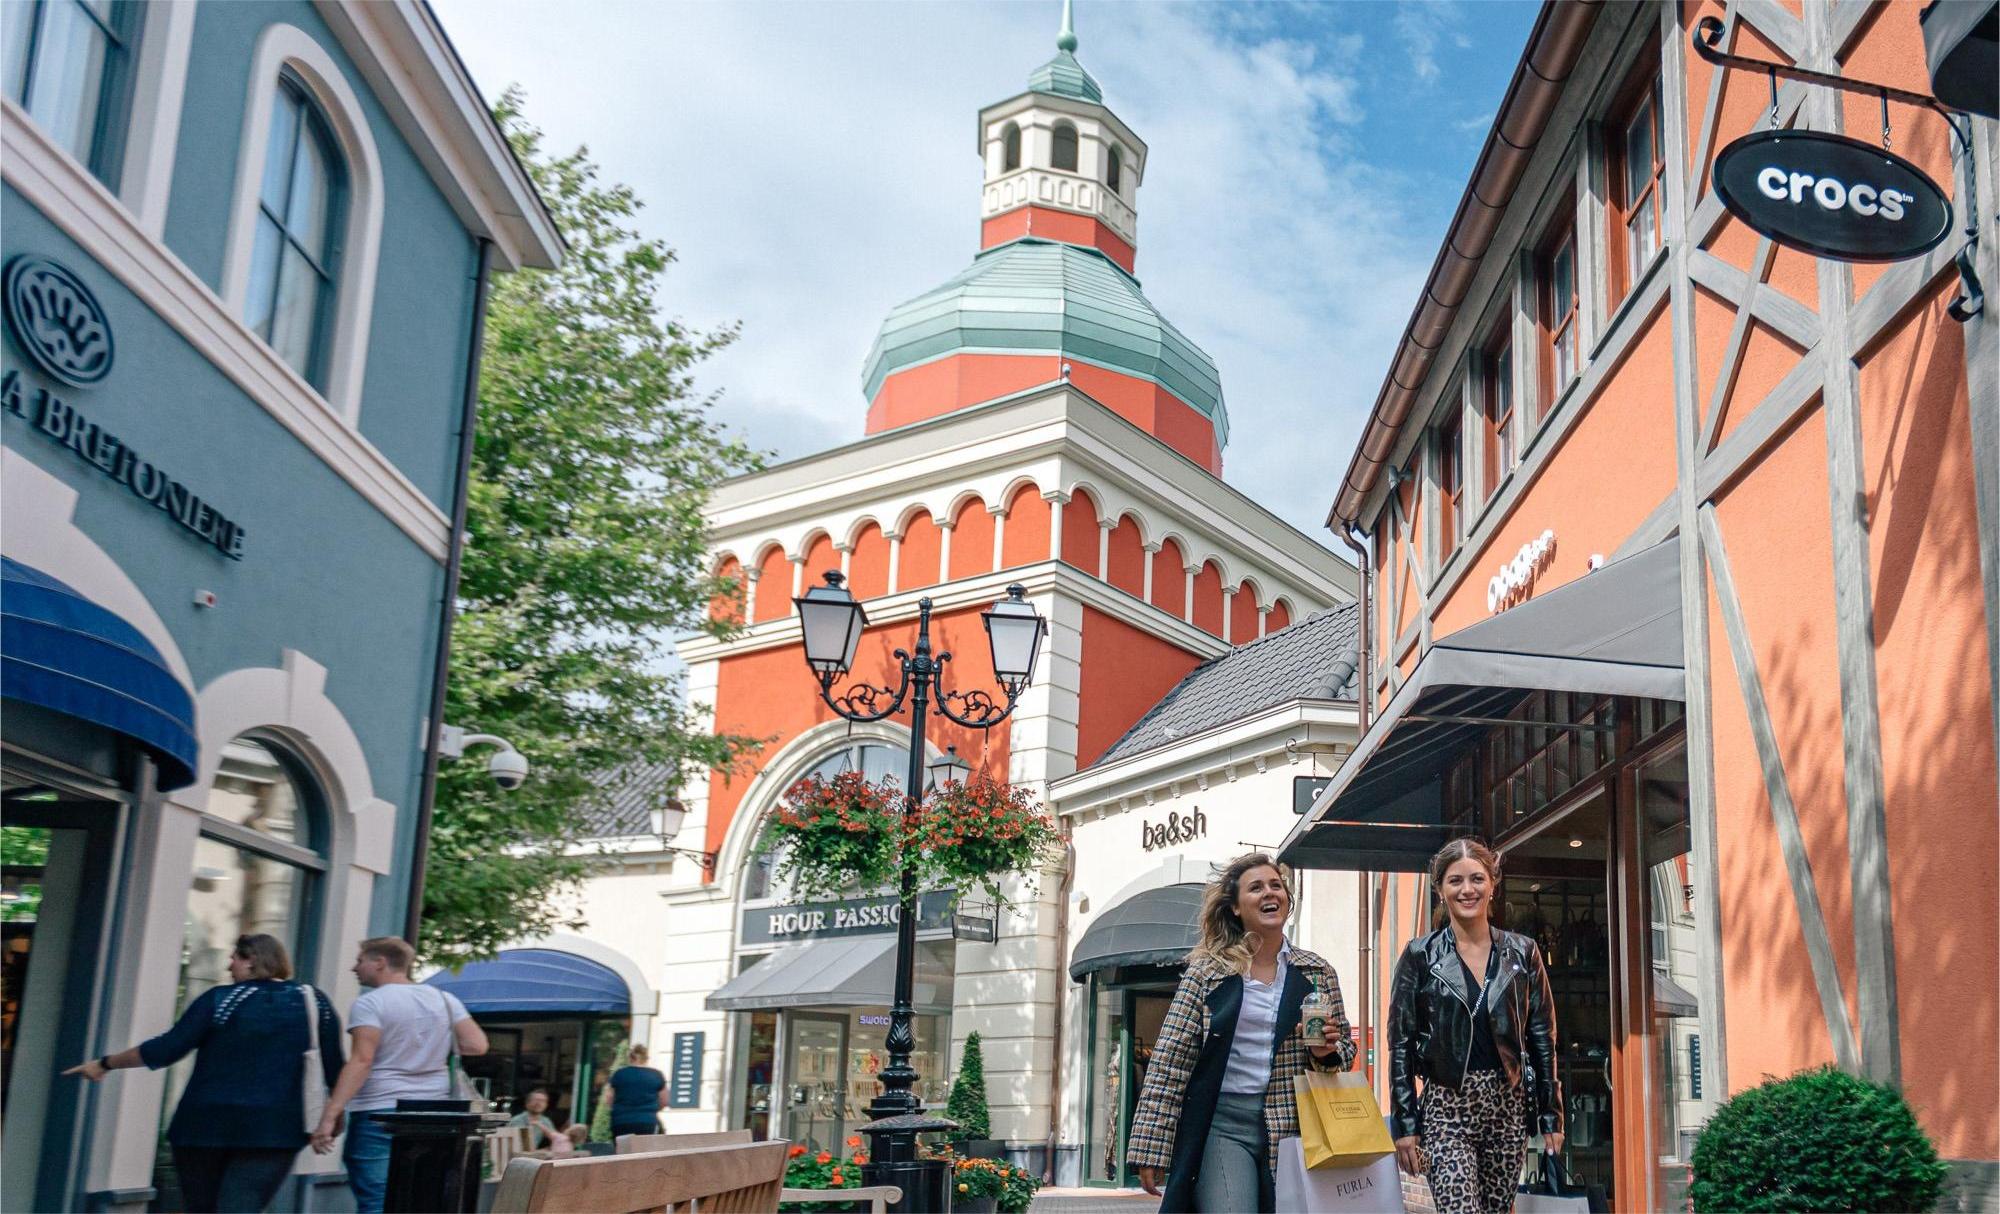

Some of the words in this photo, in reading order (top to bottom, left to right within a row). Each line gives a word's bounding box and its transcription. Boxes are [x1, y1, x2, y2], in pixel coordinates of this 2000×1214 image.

[1758, 167, 1905, 221] crocs
[32, 388, 245, 562] BRETONIERE
[1143, 806, 1206, 851] ba&sh
[768, 911, 827, 934] HOUR
[1336, 1176, 1373, 1197] FURLA
